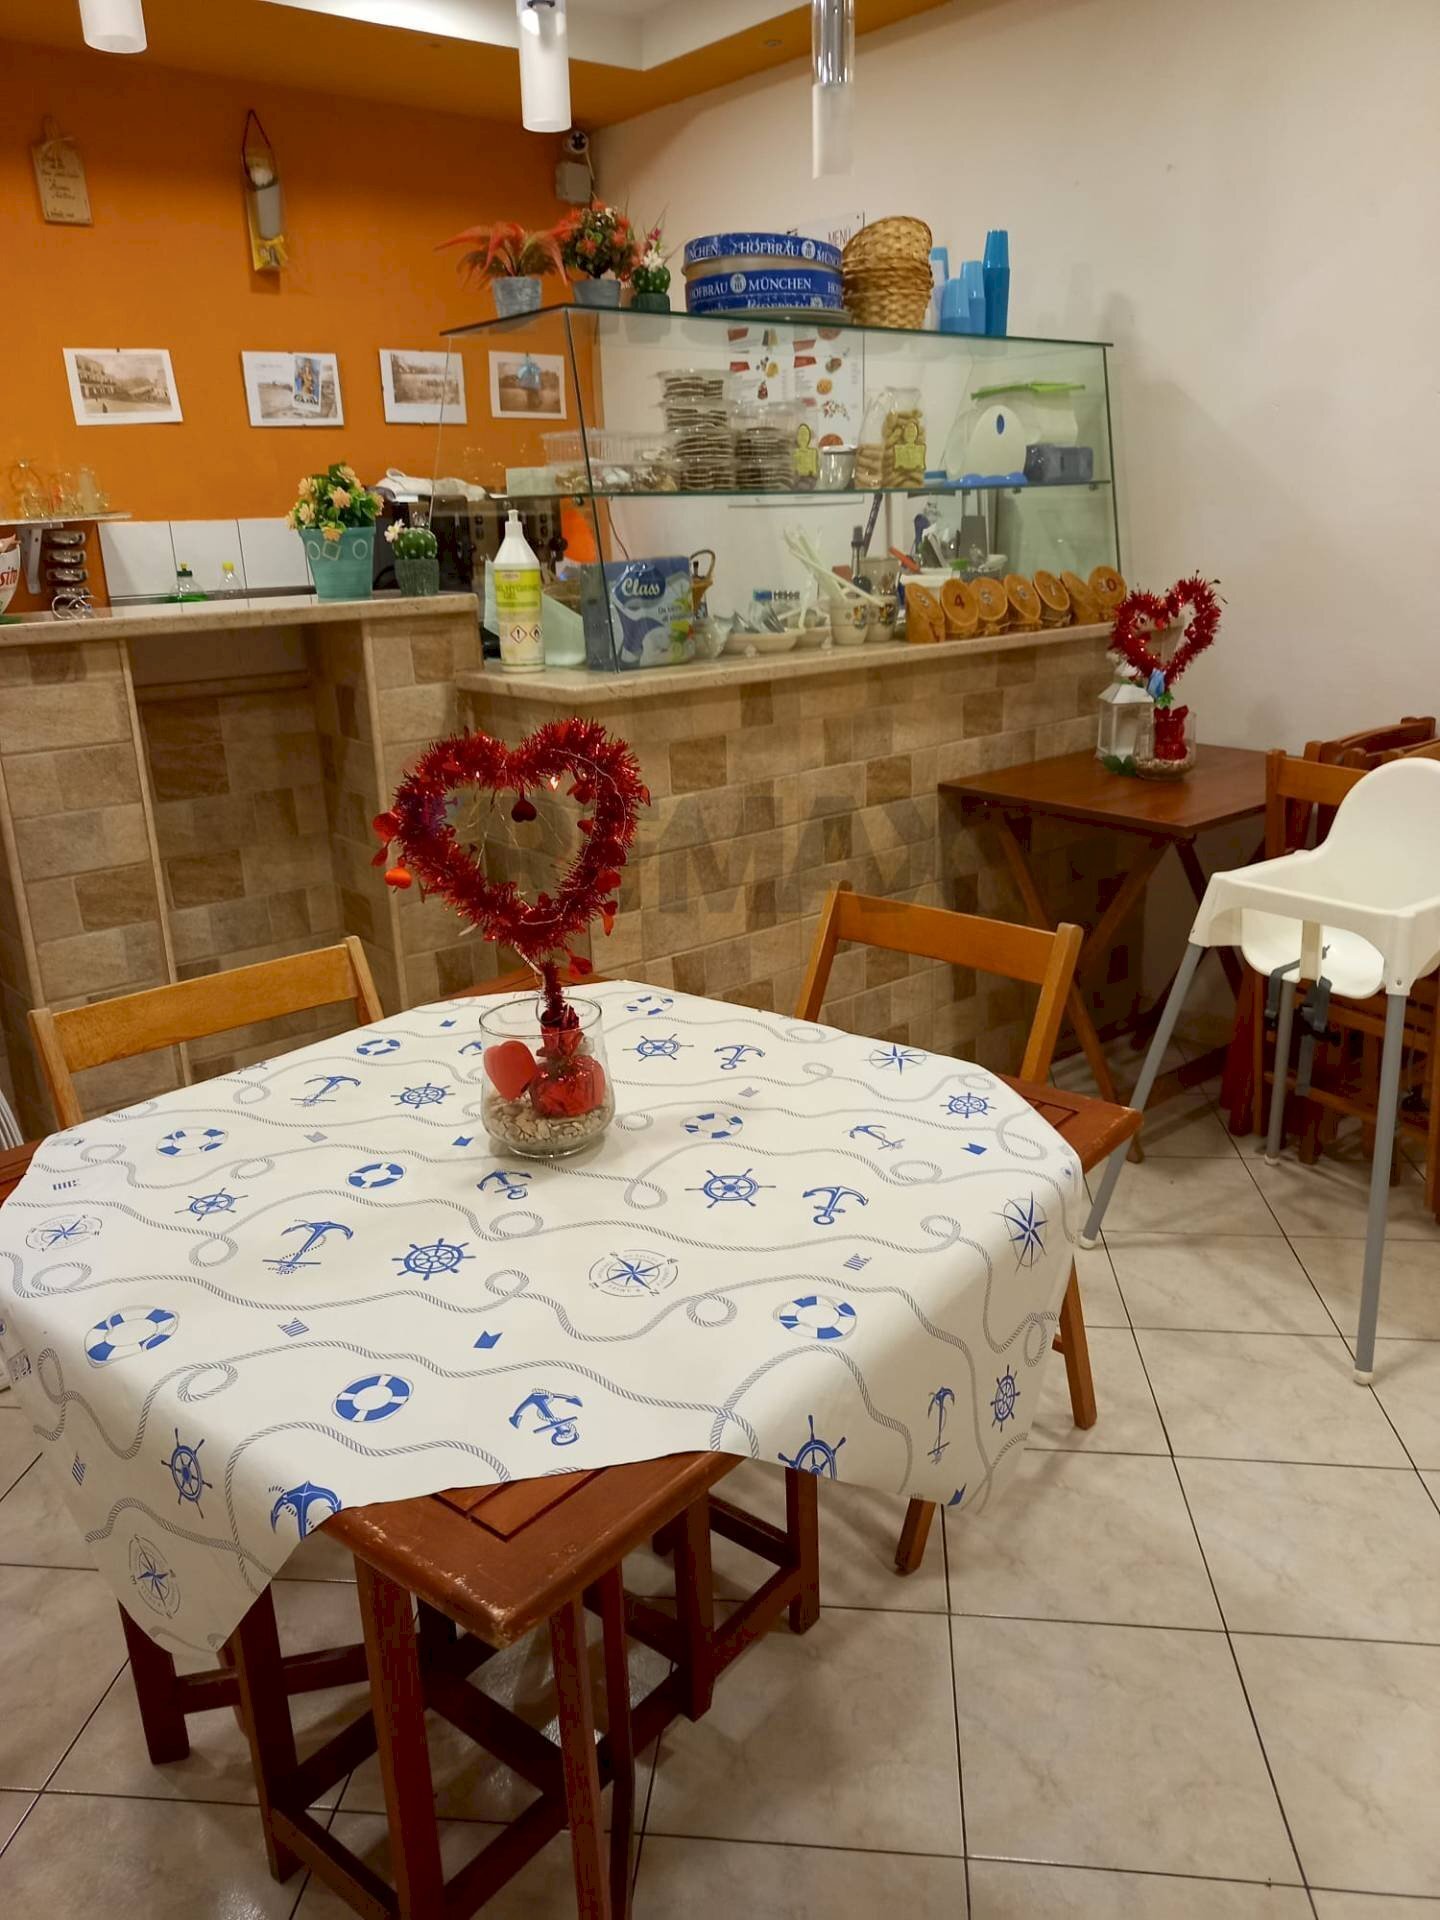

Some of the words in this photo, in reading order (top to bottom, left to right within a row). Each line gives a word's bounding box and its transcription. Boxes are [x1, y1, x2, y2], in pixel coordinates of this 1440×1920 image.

[749, 277, 811, 291] MÜNCHEN
[621, 577, 660, 597] Class
[954, 593, 965, 609] 4
